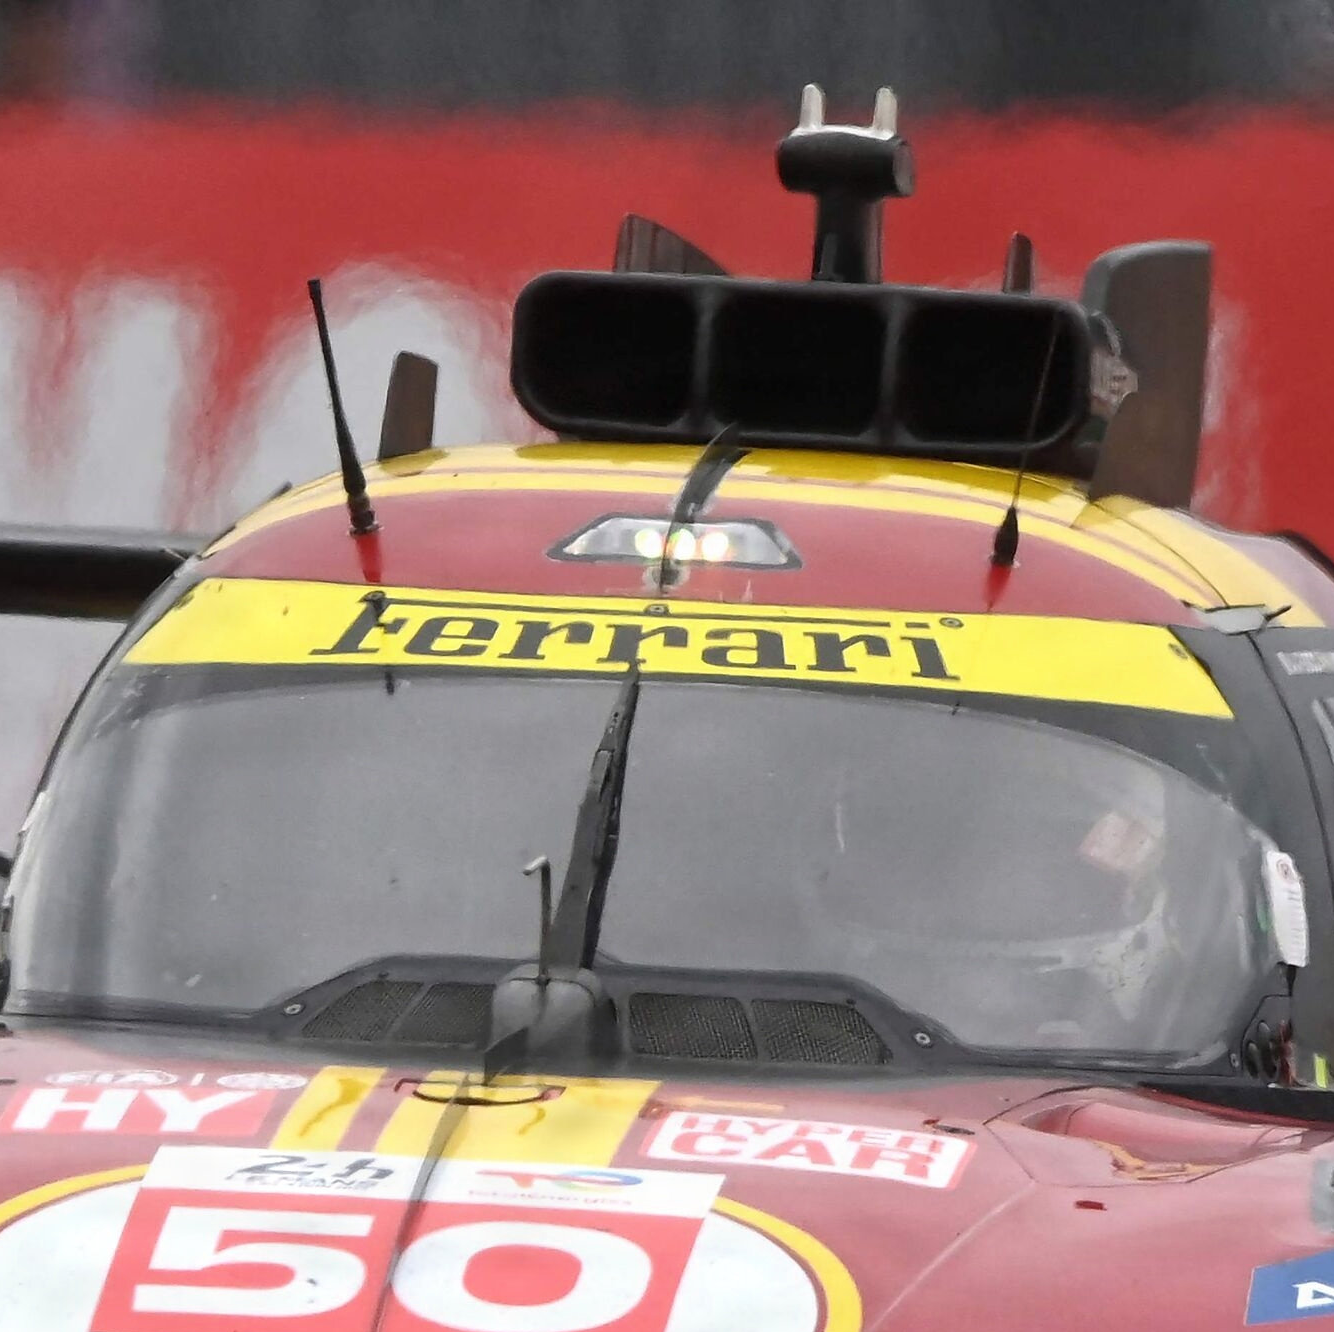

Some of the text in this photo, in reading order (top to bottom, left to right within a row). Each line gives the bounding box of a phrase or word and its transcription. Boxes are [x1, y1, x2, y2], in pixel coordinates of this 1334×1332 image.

[309, 594, 961, 681] Ferrari
[11, 1087, 260, 1133] HY
[671, 1131, 936, 1180] CAR
[680, 1114, 946, 1155] HYPER
